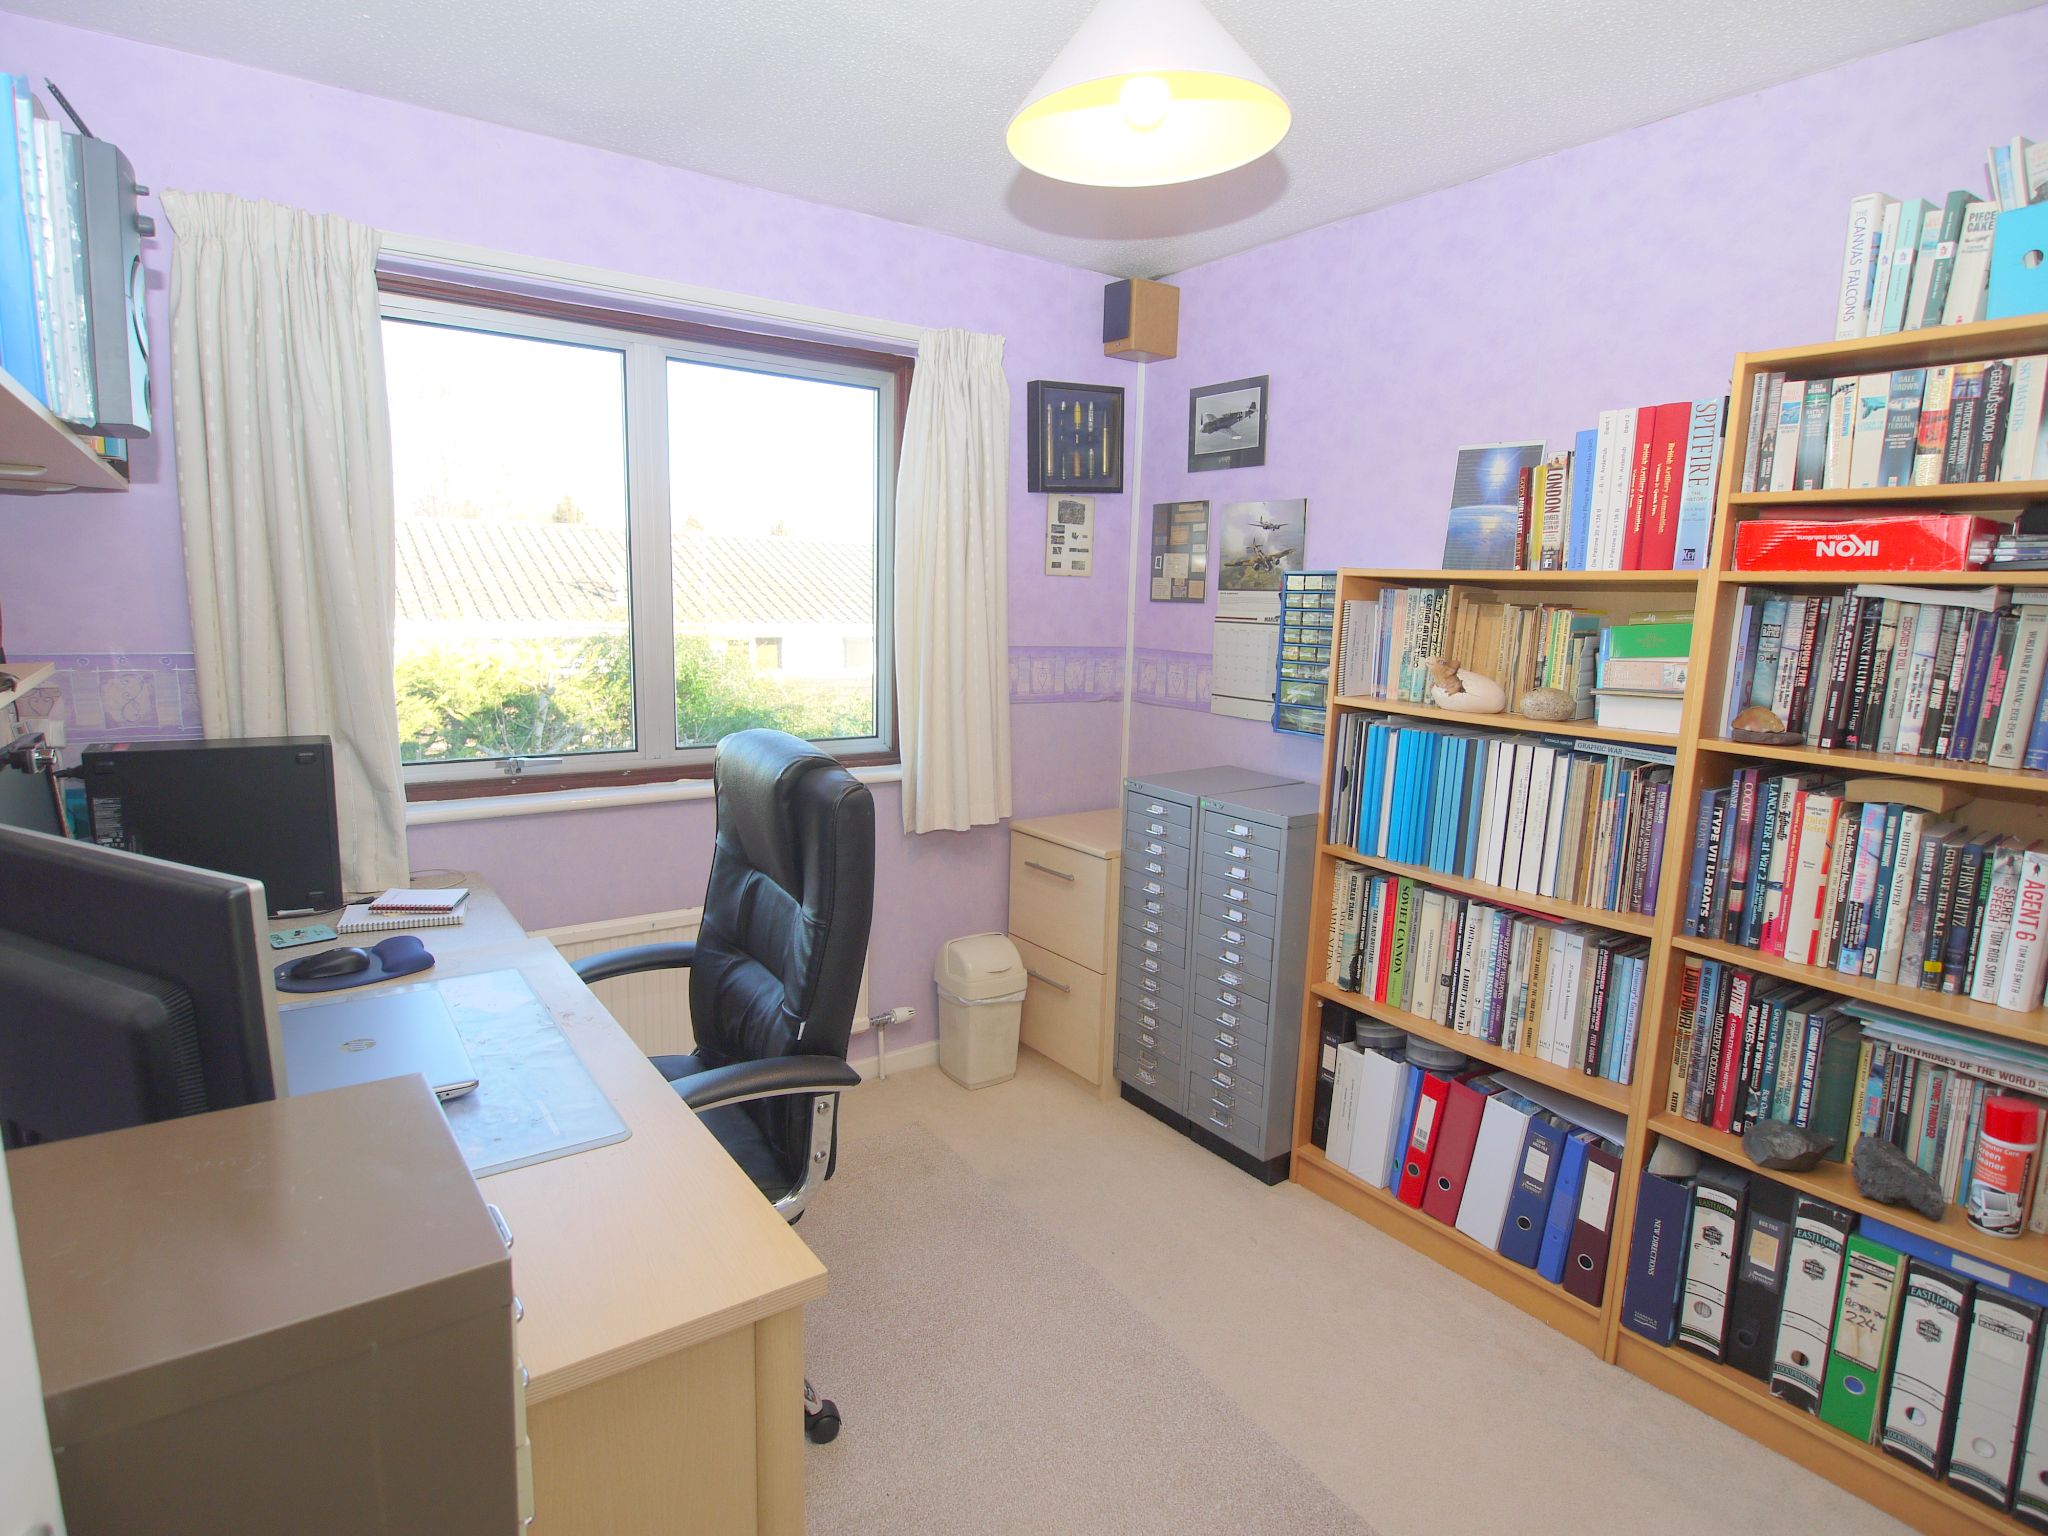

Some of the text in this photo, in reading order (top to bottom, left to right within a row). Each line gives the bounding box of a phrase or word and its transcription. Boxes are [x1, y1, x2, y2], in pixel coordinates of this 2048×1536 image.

[1967, 221, 1994, 232] CAKE
[1843, 217, 1867, 322] CANVAS FALCONS
[1843, 397, 1851, 412] DALE
[1987, 369, 2003, 401] GERALD
[2012, 362, 2031, 432] SKY MASTERS
[1952, 417, 1961, 438] SHARK
[1956, 401, 1973, 464] PATRICK ROBINSON
[1981, 403, 1996, 442] SEYMOUR
[1641, 443, 1650, 464] British
[1666, 443, 1675, 464] British
[1687, 403, 1718, 488] SPITFIRE
[1948, 440, 1958, 464] MUTINY
[1544, 467, 1564, 514] LONDON
[1638, 467, 1647, 493] Artillery
[1662, 466, 1672, 493] Artillery
[1816, 535, 1879, 557] IKON
[1420, 594, 1433, 658] GERMAN ARTILLERY
[1432, 611, 1441, 642] Cartridge
[1797, 598, 1820, 687] FLYING THROUGH FIRE
[1896, 616, 1913, 671] DESIGNED TO KILL
[1837, 631, 1854, 681] ACTION
[2021, 630, 2038, 669] WORLD WAR
[1848, 624, 1875, 731] TANK KILLING Ian Hogg
[1992, 669, 2007, 706] ARTILLERY
[1577, 741, 1607, 751] GRAPHIC
[1729, 780, 1740, 809] GUNNER
[1740, 783, 1754, 823] COCKPIT
[1641, 787, 1656, 872] EARLY AIRCRAFT ARMAMENT
[1697, 806, 1710, 848] U-BOATS
[1759, 784, 1779, 872] LANCASTER at War
[1700, 809, 1722, 917] TYPE VII U-BOATS
[1837, 824, 1856, 902] The Havilland Mosquito
[1892, 814, 1913, 906] The BRITISH SNIPER
[1917, 842, 1936, 904] BARNES WALLIS'
[1979, 858, 1993, 900] BATTLEZONE
[1853, 871, 1868, 899] Album
[1932, 849, 1956, 937] GUNS OF THE R.A.F.
[1951, 854, 1975, 927] The FIRST BLITZ
[1988, 886, 2004, 922] SPEECH
[2000, 889, 2015, 925] SECRET
[1393, 885, 1410, 974] SOVIET CANNON
[2012, 880, 2046, 994] AGENT 6 TOM ROB SMITH
[1484, 916, 1500, 1012] AMERICAN ARSENAL
[1498, 938, 1510, 999] ARTILLERY WEAPONS
[1983, 930, 2003, 988] TOM ROB SMITH
[1594, 950, 1609, 1031] ARMOURED FIREPOWER
[1630, 967, 1641, 1002] Germany's
[1678, 968, 1698, 1029] LAND POWER
[1701, 976, 1712, 1005] AIRFIELDS
[1721, 977, 1747, 1092] SPITFIRE COMPLETE FIGHTING HISTORY
[1745, 1005, 1758, 1044] PILLBOXES
[1753, 1004, 1769, 1069] SWASTIKA WAR
[1765, 1009, 1781, 1074] GHOSTS BIGGIN HILL
[1783, 1030, 1792, 1049] WORLD
[1705, 1013, 1724, 1095] MILITARY MODELLING
[1783, 1021, 1801, 1106] BRITISH AMERICAN ARTILLERY
[1799, 1027, 1818, 1122] GERMAN ARTILLERY WORLD WAR
[1960, 1061, 1973, 1070] OF
[1977, 1065, 1995, 1077] THE
[1999, 1071, 2036, 1089] WORLD
[1670, 1092, 1679, 1112] EXETER
[1855, 1091, 1864, 1127] HANDICRAFTS
[1926, 1104, 1939, 1139] THUNDER
[1698, 1200, 1733, 1217] EASTLIGHT
[1647, 1219, 1661, 1276] NEW DIRECTIONS
[1797, 1229, 1841, 1251] EASTLIGHT
[1910, 1286, 1958, 1313] EASTLIGHT
[1845, 1311, 1878, 1333] 224
